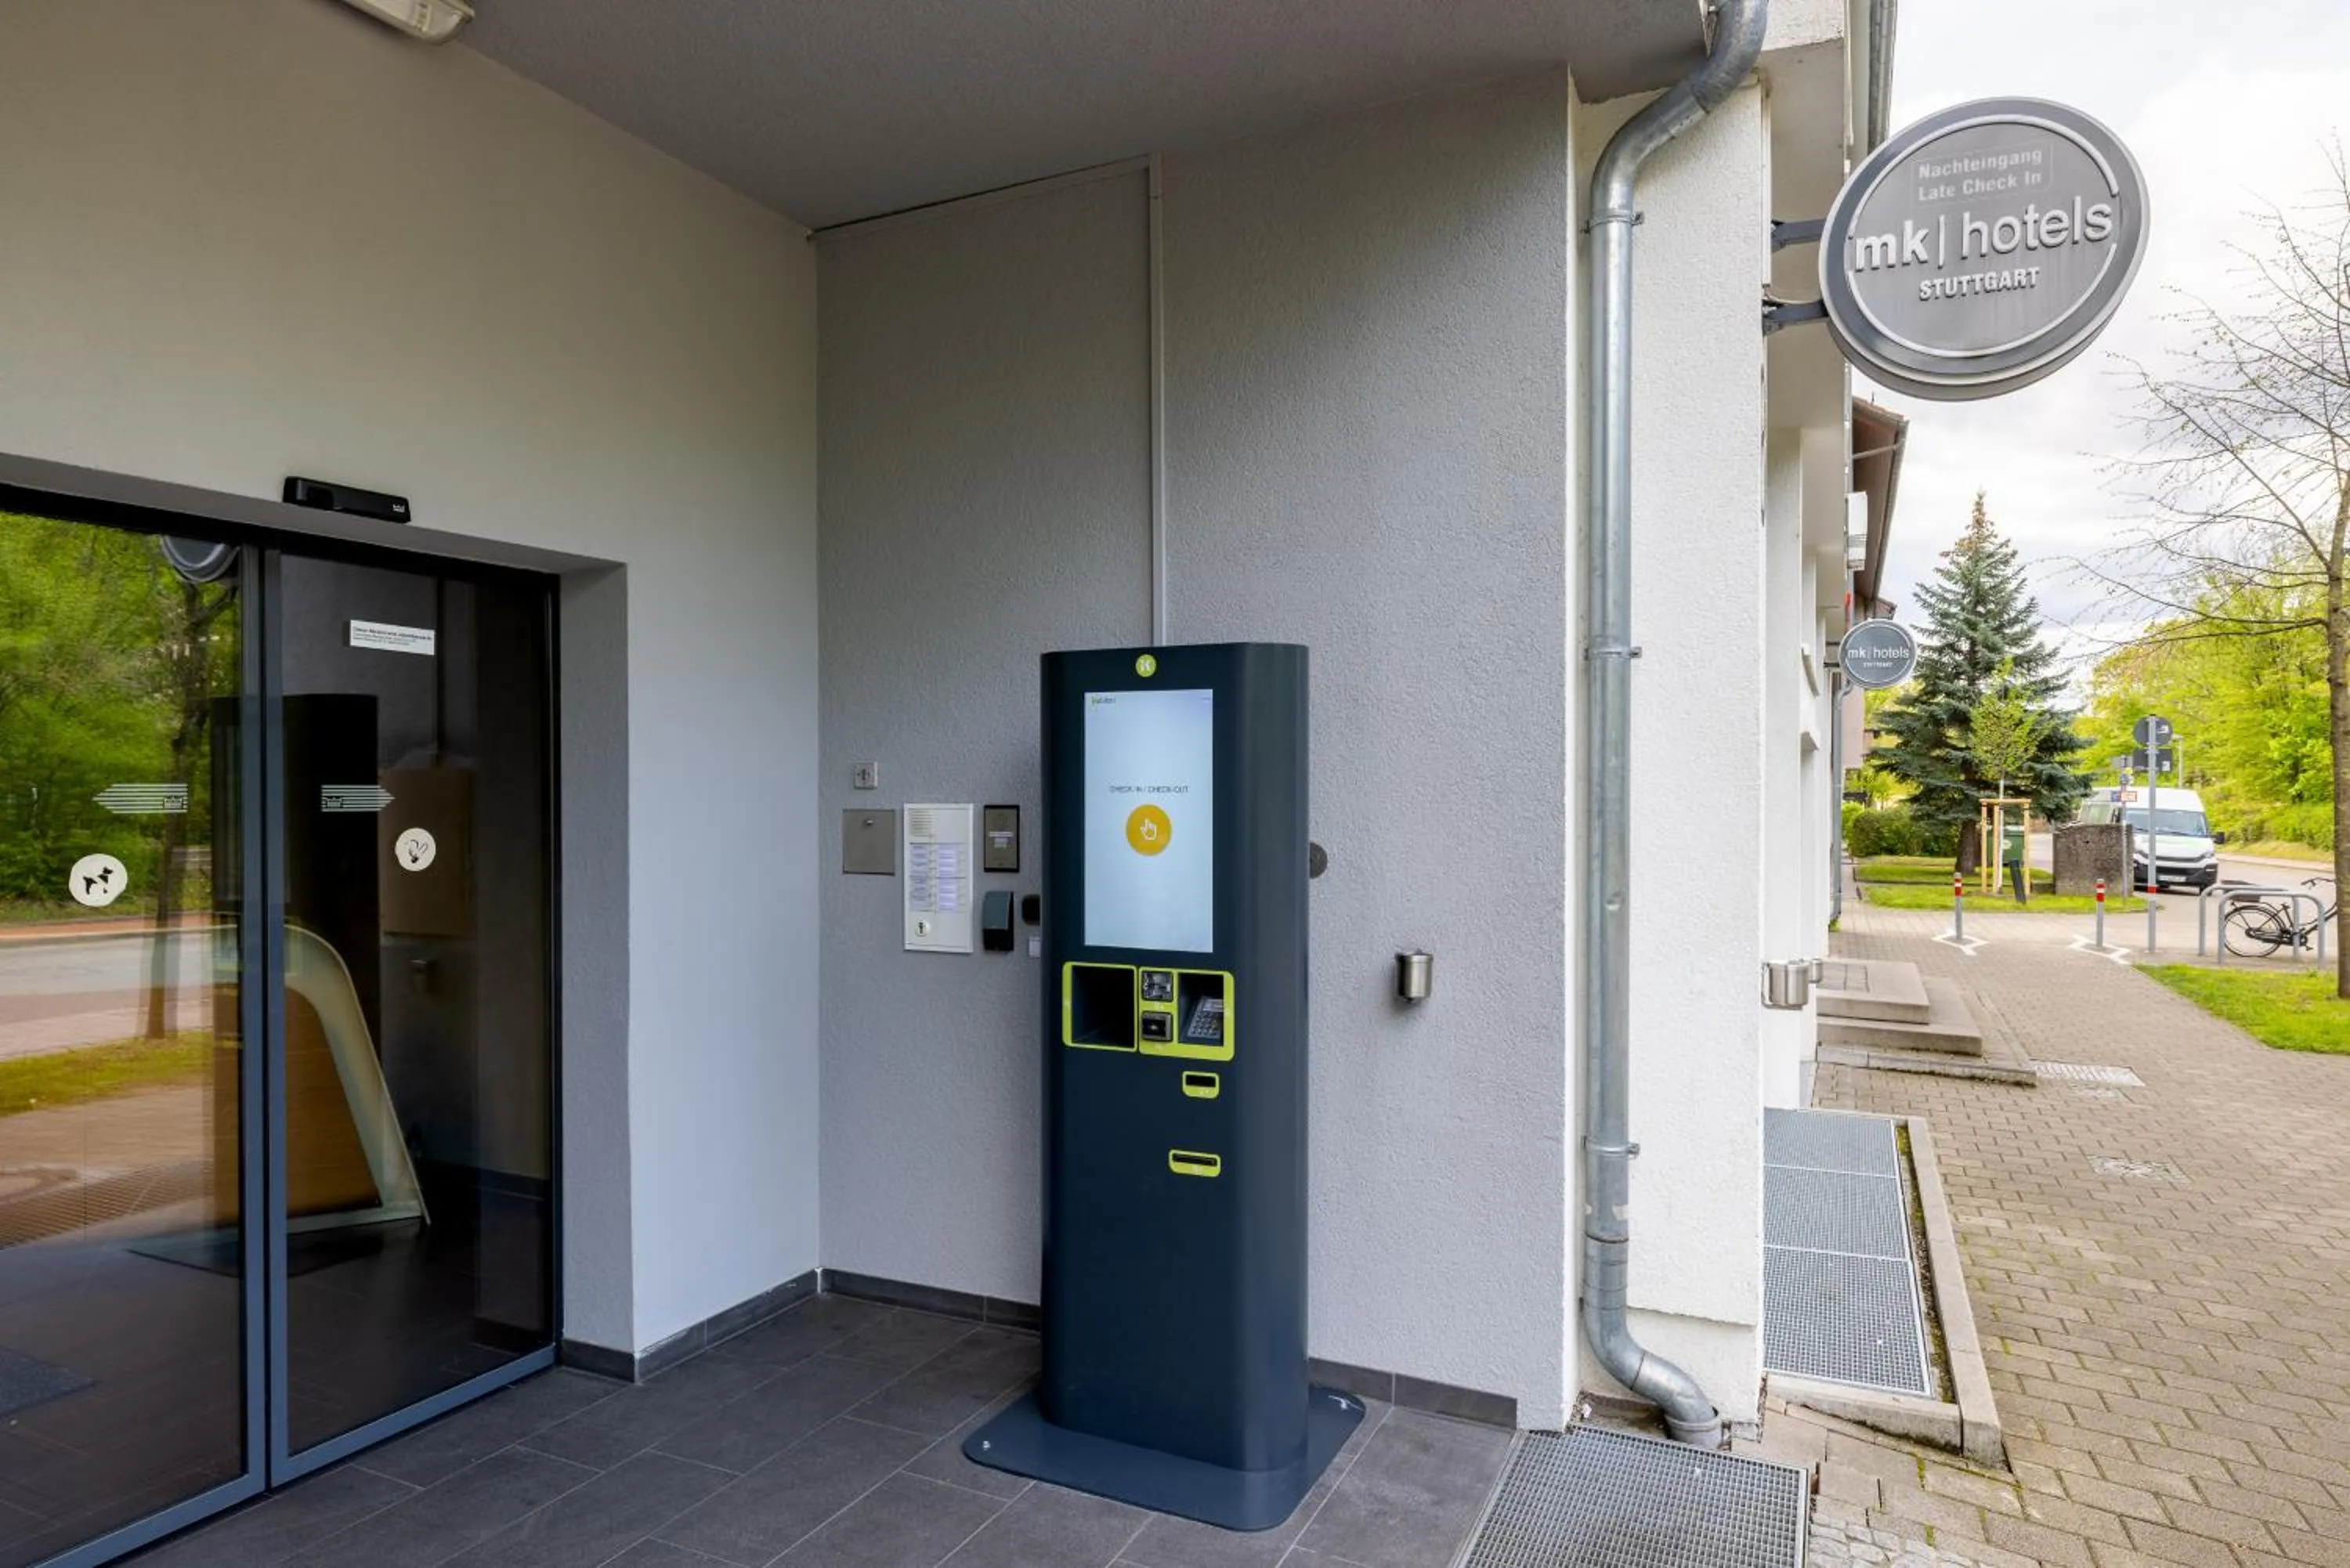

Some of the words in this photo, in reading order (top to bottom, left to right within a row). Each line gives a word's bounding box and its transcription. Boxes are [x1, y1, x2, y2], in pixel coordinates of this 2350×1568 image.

[1919, 149, 2042, 179] Nachteingang
[1918, 184, 1956, 202] Late
[1962, 177, 2018, 196] Check
[2025, 171, 2042, 185] In
[1854, 219, 1929, 273] mk
[1961, 196, 2113, 260] hotels
[1918, 266, 2041, 301] STUTTGART
[1848, 647, 1867, 659] mk
[1873, 646, 1910, 659] hotels
